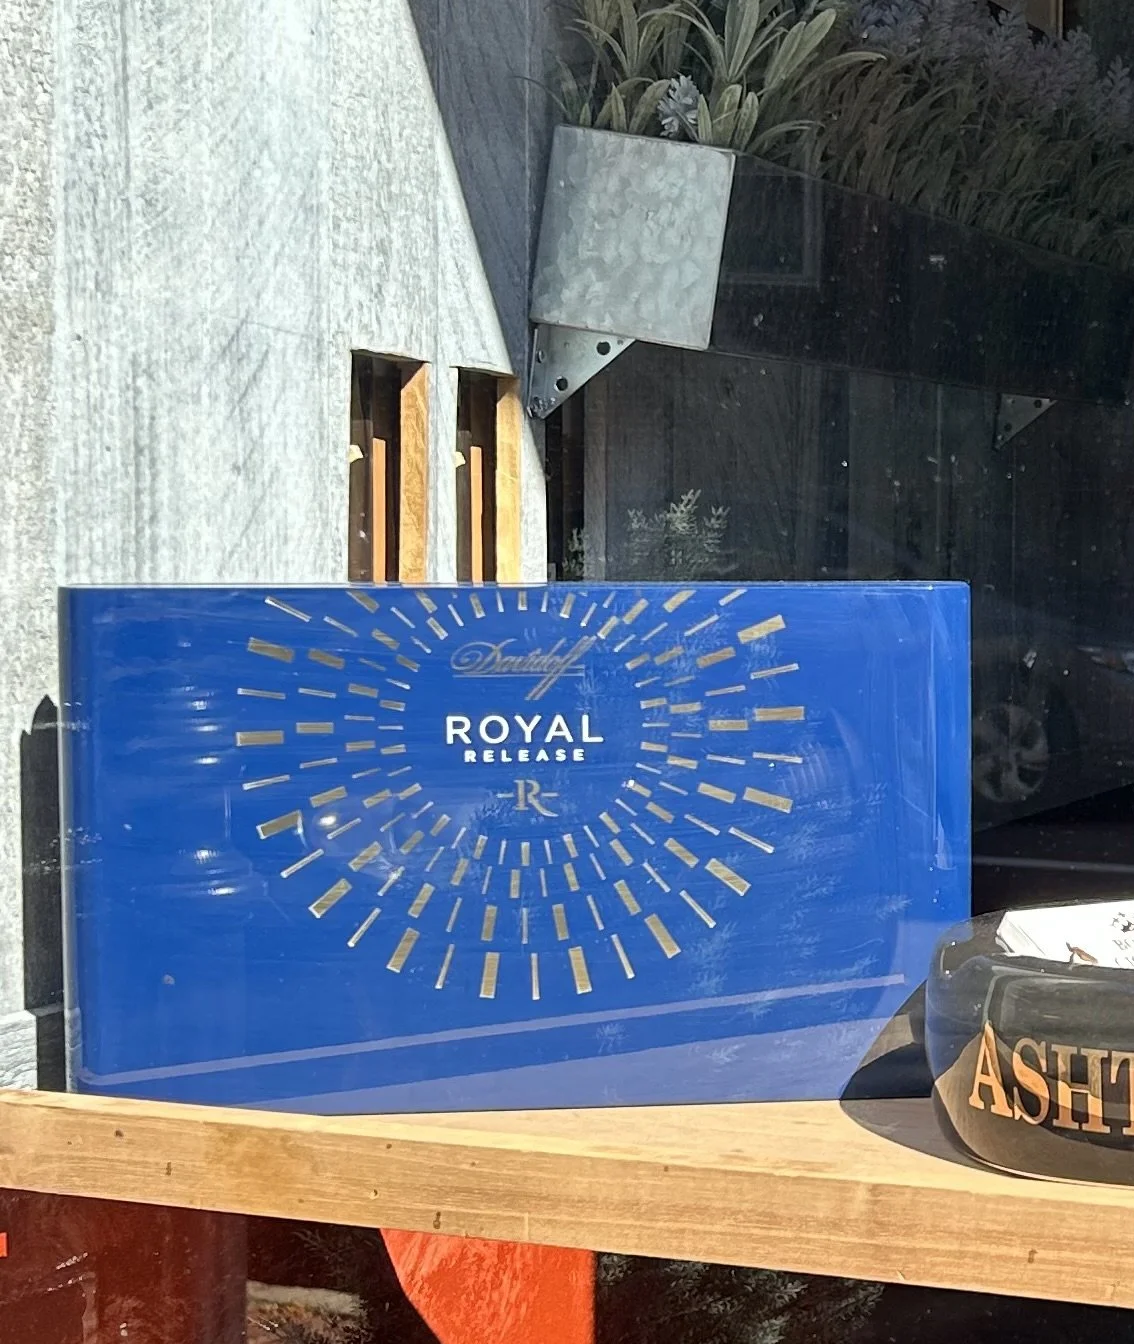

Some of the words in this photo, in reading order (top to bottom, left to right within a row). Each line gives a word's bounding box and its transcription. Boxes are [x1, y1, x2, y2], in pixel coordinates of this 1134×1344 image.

[450, 635, 598, 701] Davidoff
[445, 714, 605, 745] ROYAL
[463, 748, 586, 764] RELEASE
